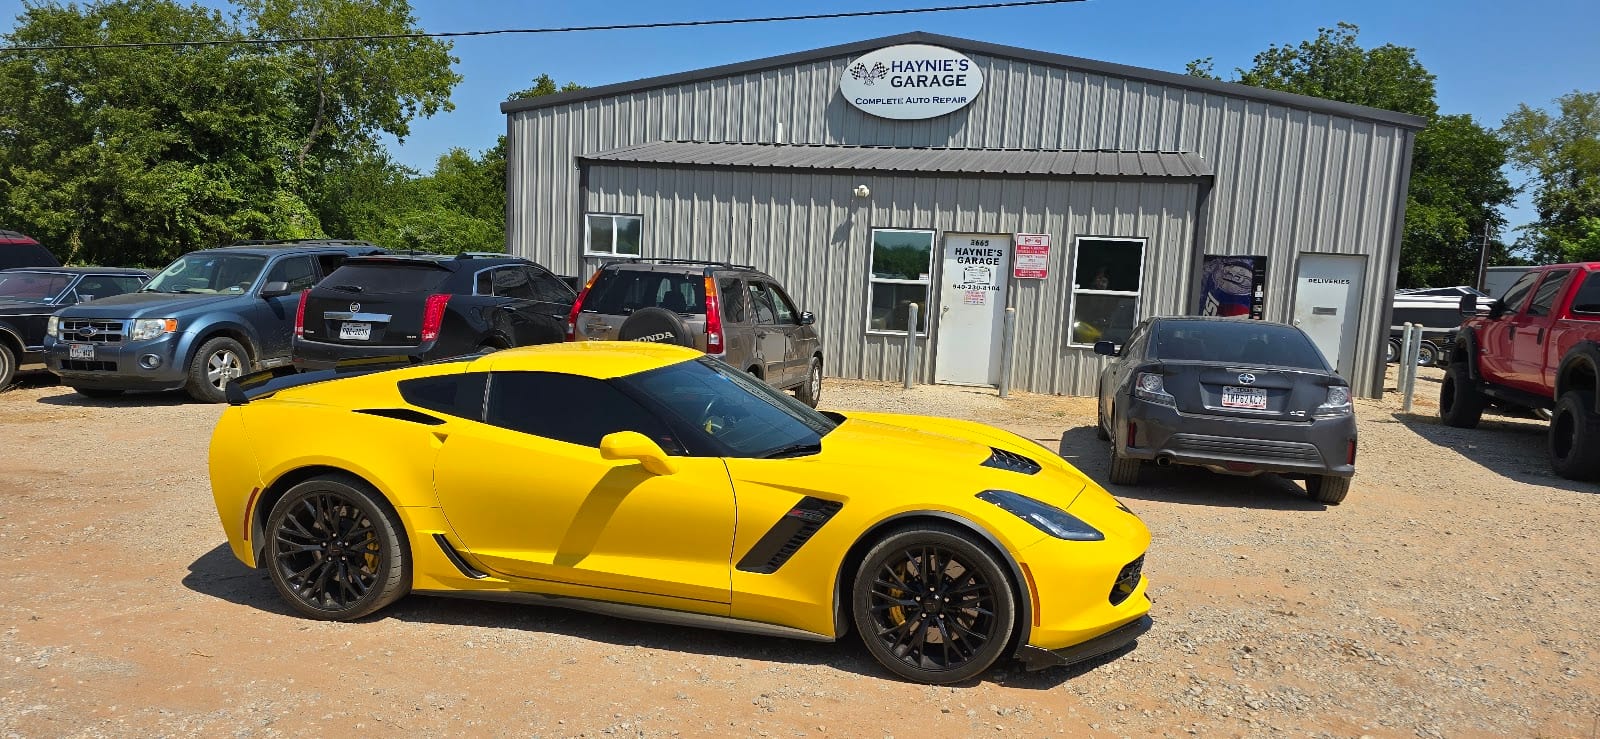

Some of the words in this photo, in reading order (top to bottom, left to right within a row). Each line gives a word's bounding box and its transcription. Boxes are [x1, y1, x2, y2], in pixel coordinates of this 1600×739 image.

[891, 58, 969, 73] HAYNIE'S
[890, 74, 967, 88] GARAGE
[905, 96, 930, 104] AUTO
[932, 96, 967, 104] REPAIR
[955, 247, 1003, 257] HAYNIE'S
[957, 256, 1000, 265] GARAGE
